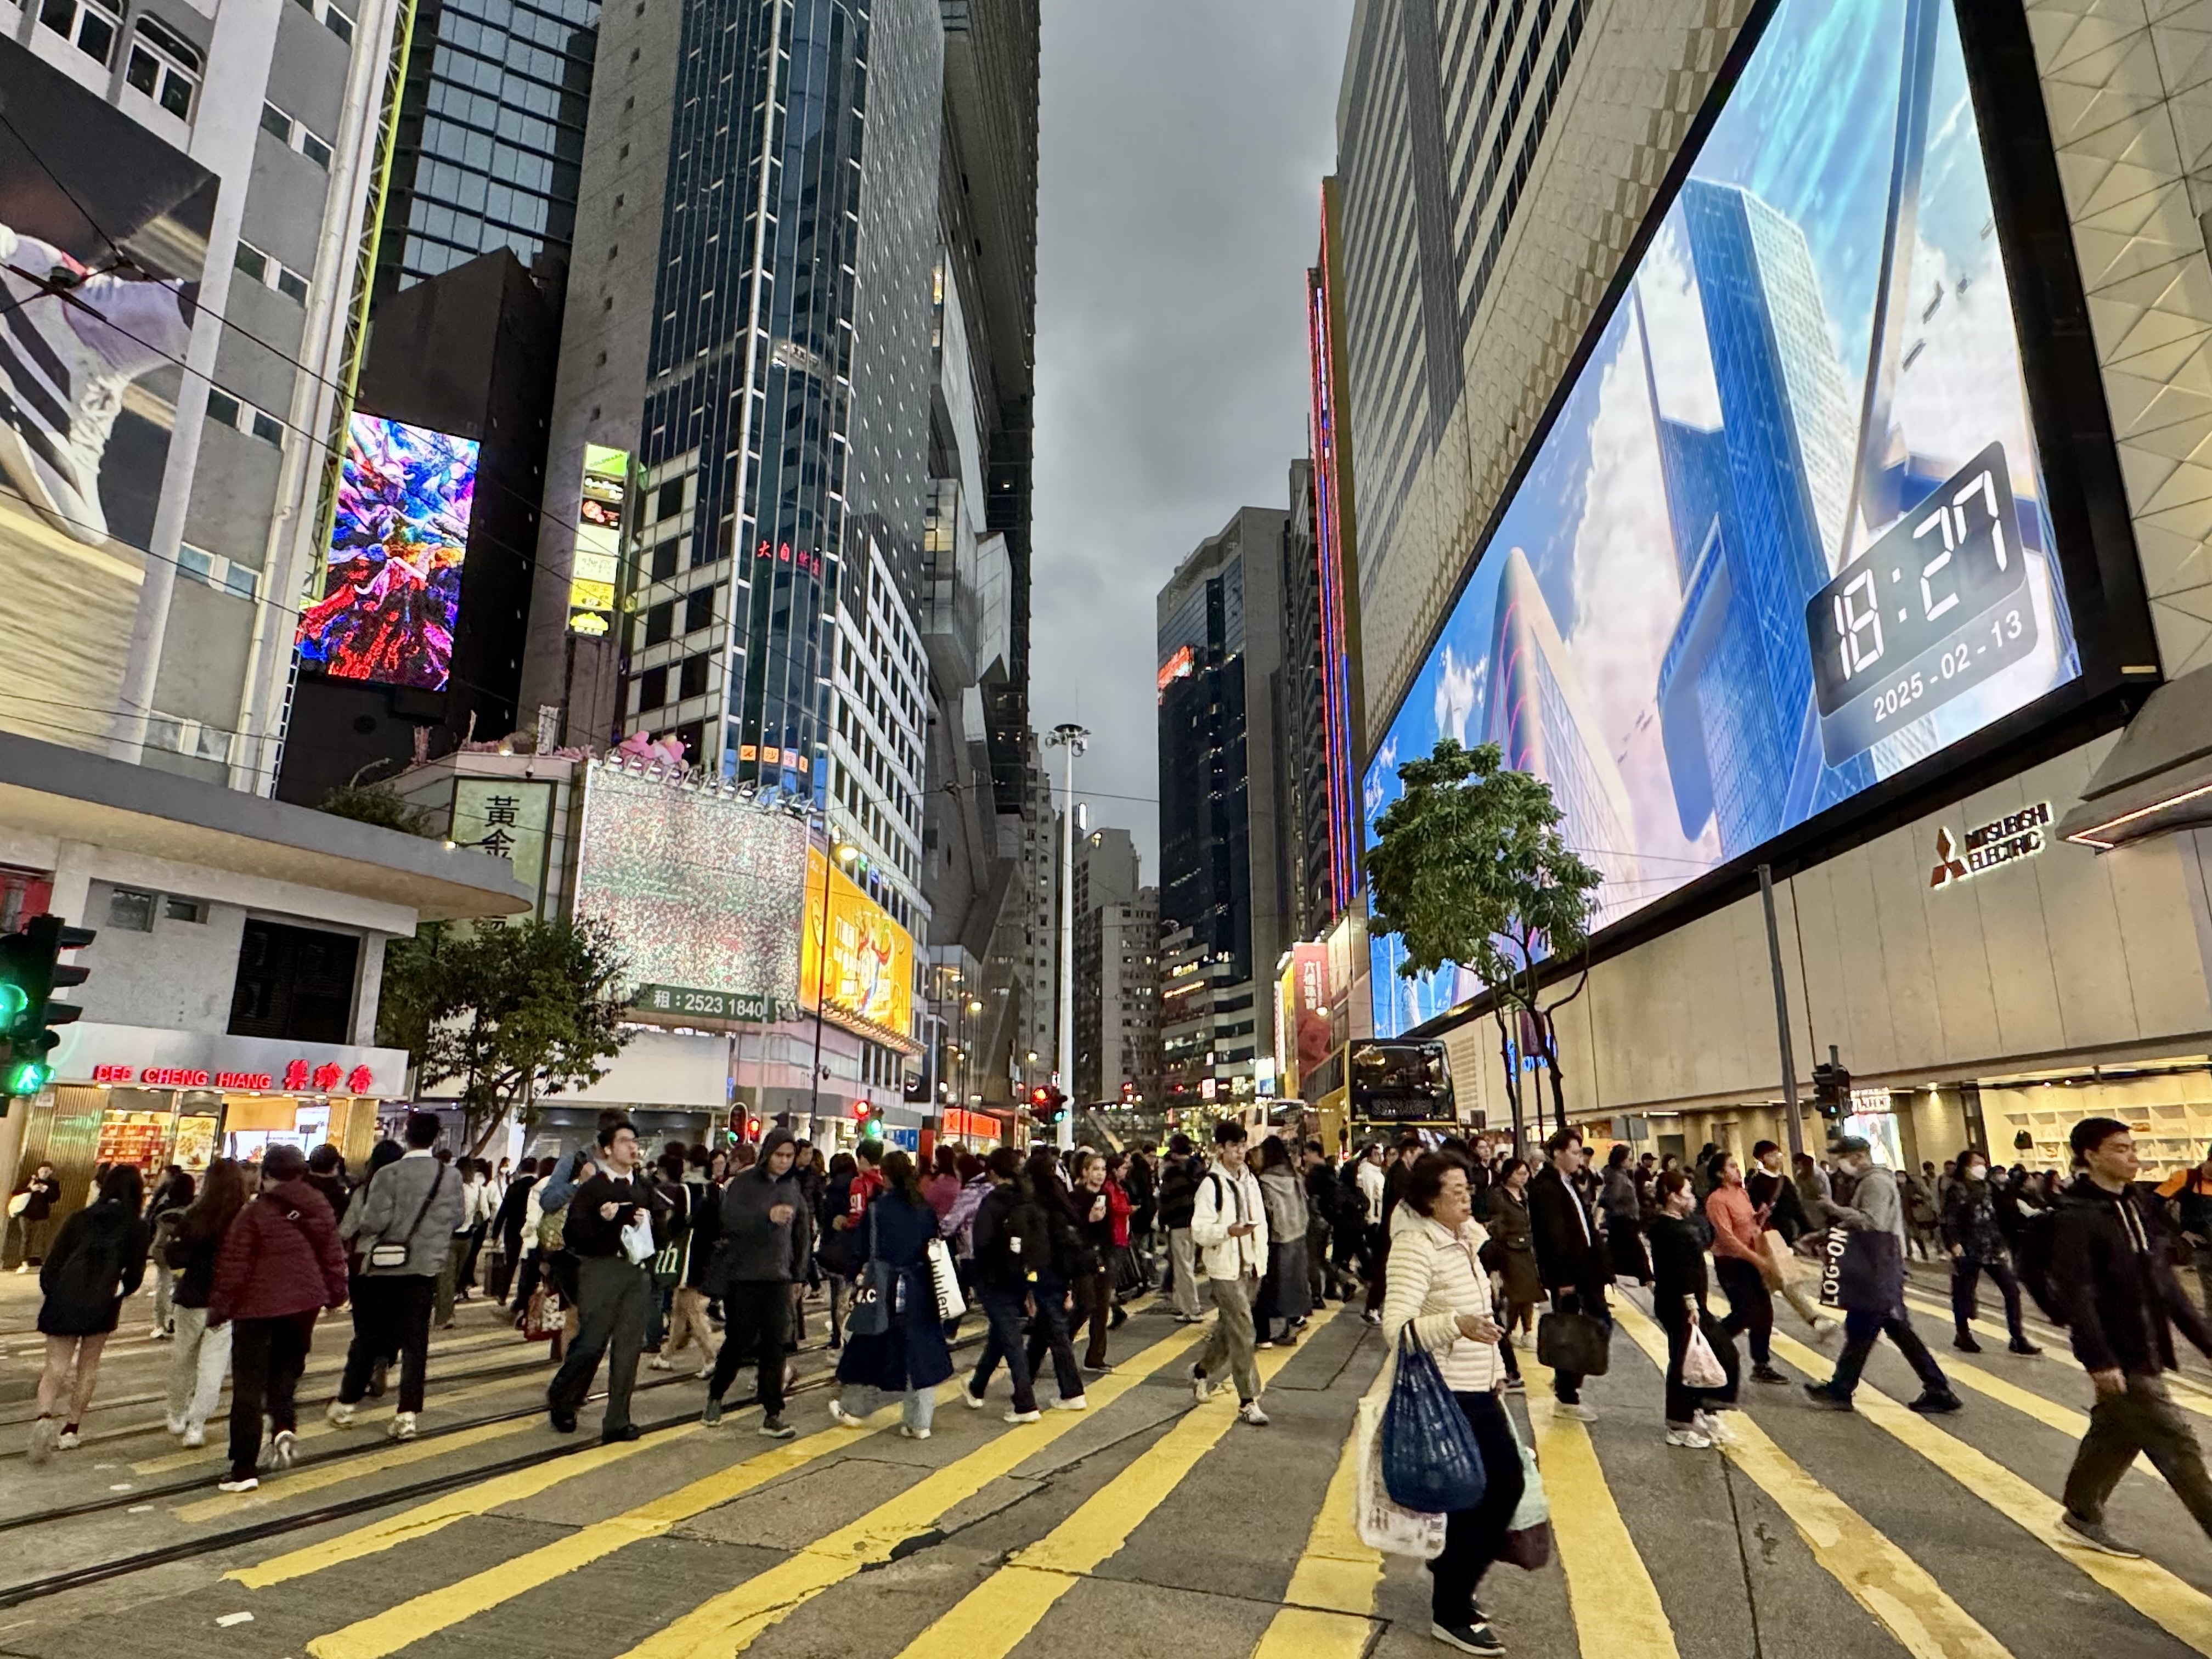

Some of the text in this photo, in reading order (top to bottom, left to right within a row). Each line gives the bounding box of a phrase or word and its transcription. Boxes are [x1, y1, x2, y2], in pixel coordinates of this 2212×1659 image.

[1835, 470, 2007, 680] 18:27
[728, 998, 764, 1018] 1840
[95, 1065, 272, 1090] BEE CHENG HIANG
[1821, 1227, 1848, 1306] LOG-ON
